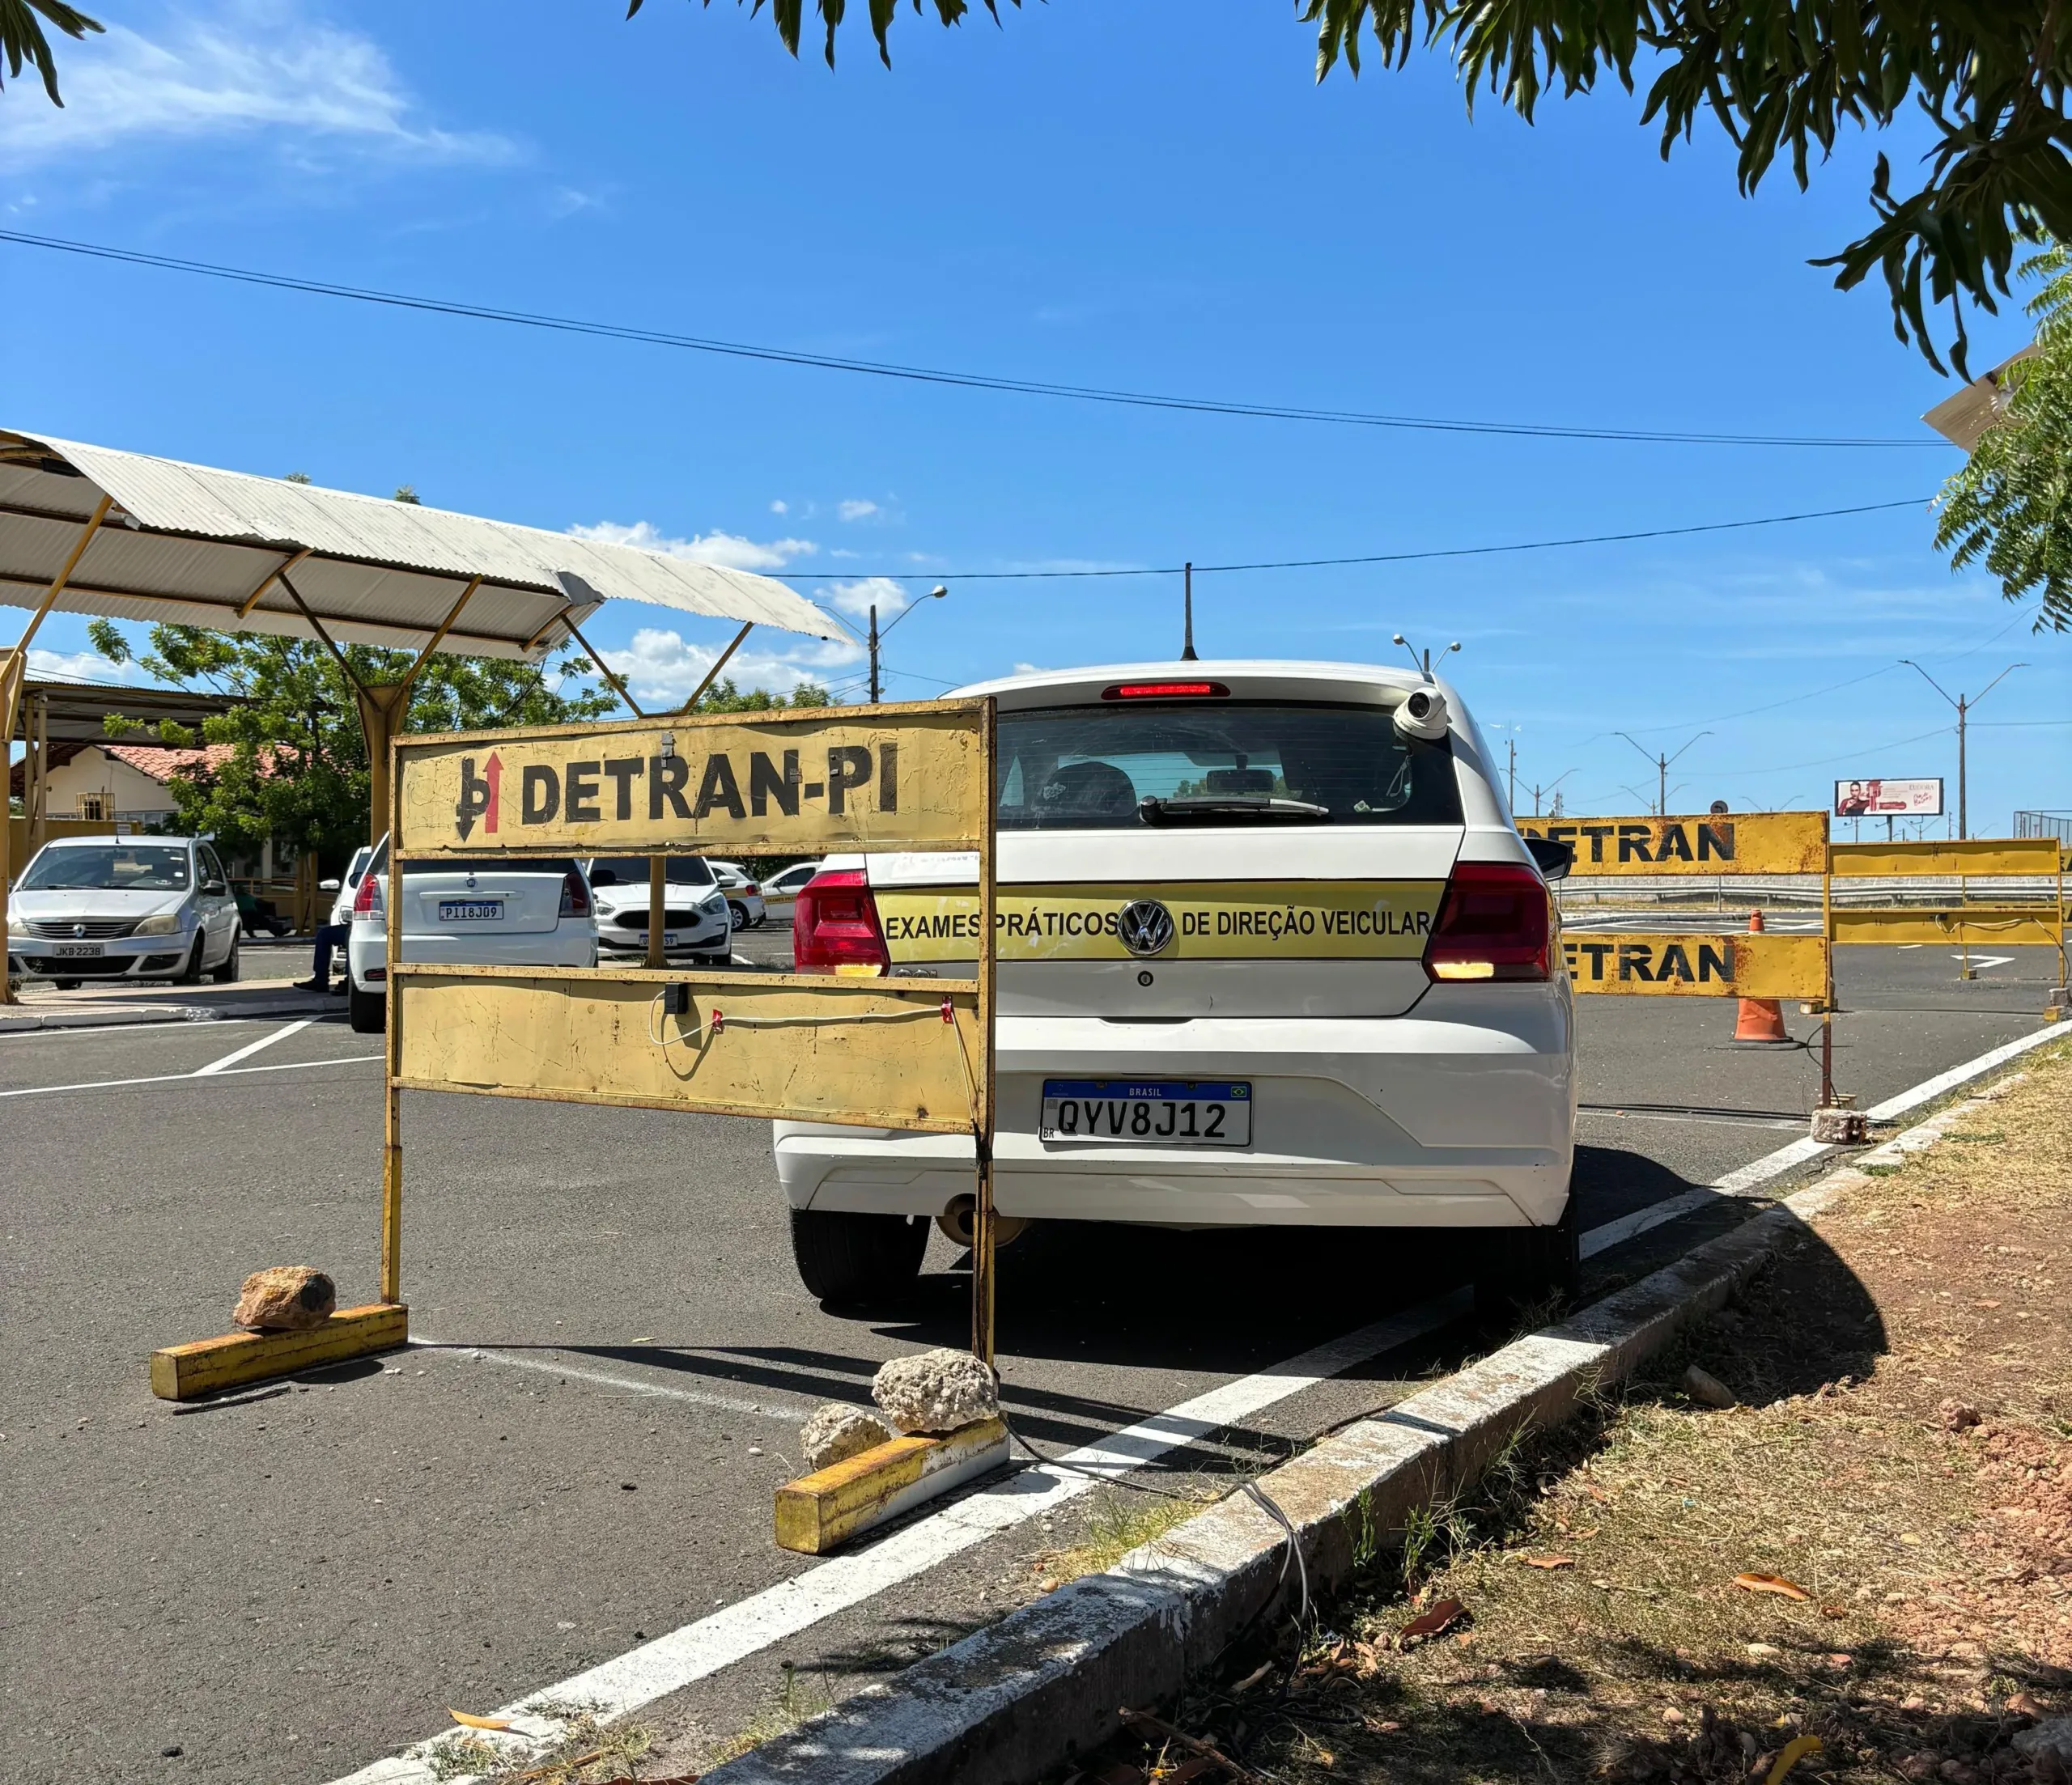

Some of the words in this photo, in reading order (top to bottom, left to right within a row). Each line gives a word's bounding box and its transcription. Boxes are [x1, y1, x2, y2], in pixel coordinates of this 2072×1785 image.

[522, 743, 897, 825] DETRAN-PI
[885, 914, 980, 939] EXAMES
[1182, 912, 1210, 935] DE
[1217, 905, 1315, 940] DIREÇÃO
[1321, 910, 1430, 935] VEICULAR
[1128, 1088, 1162, 1096] BRASIL
[1043, 1126, 1055, 1138] BR
[1058, 1100, 1225, 1138] QYV8J12
